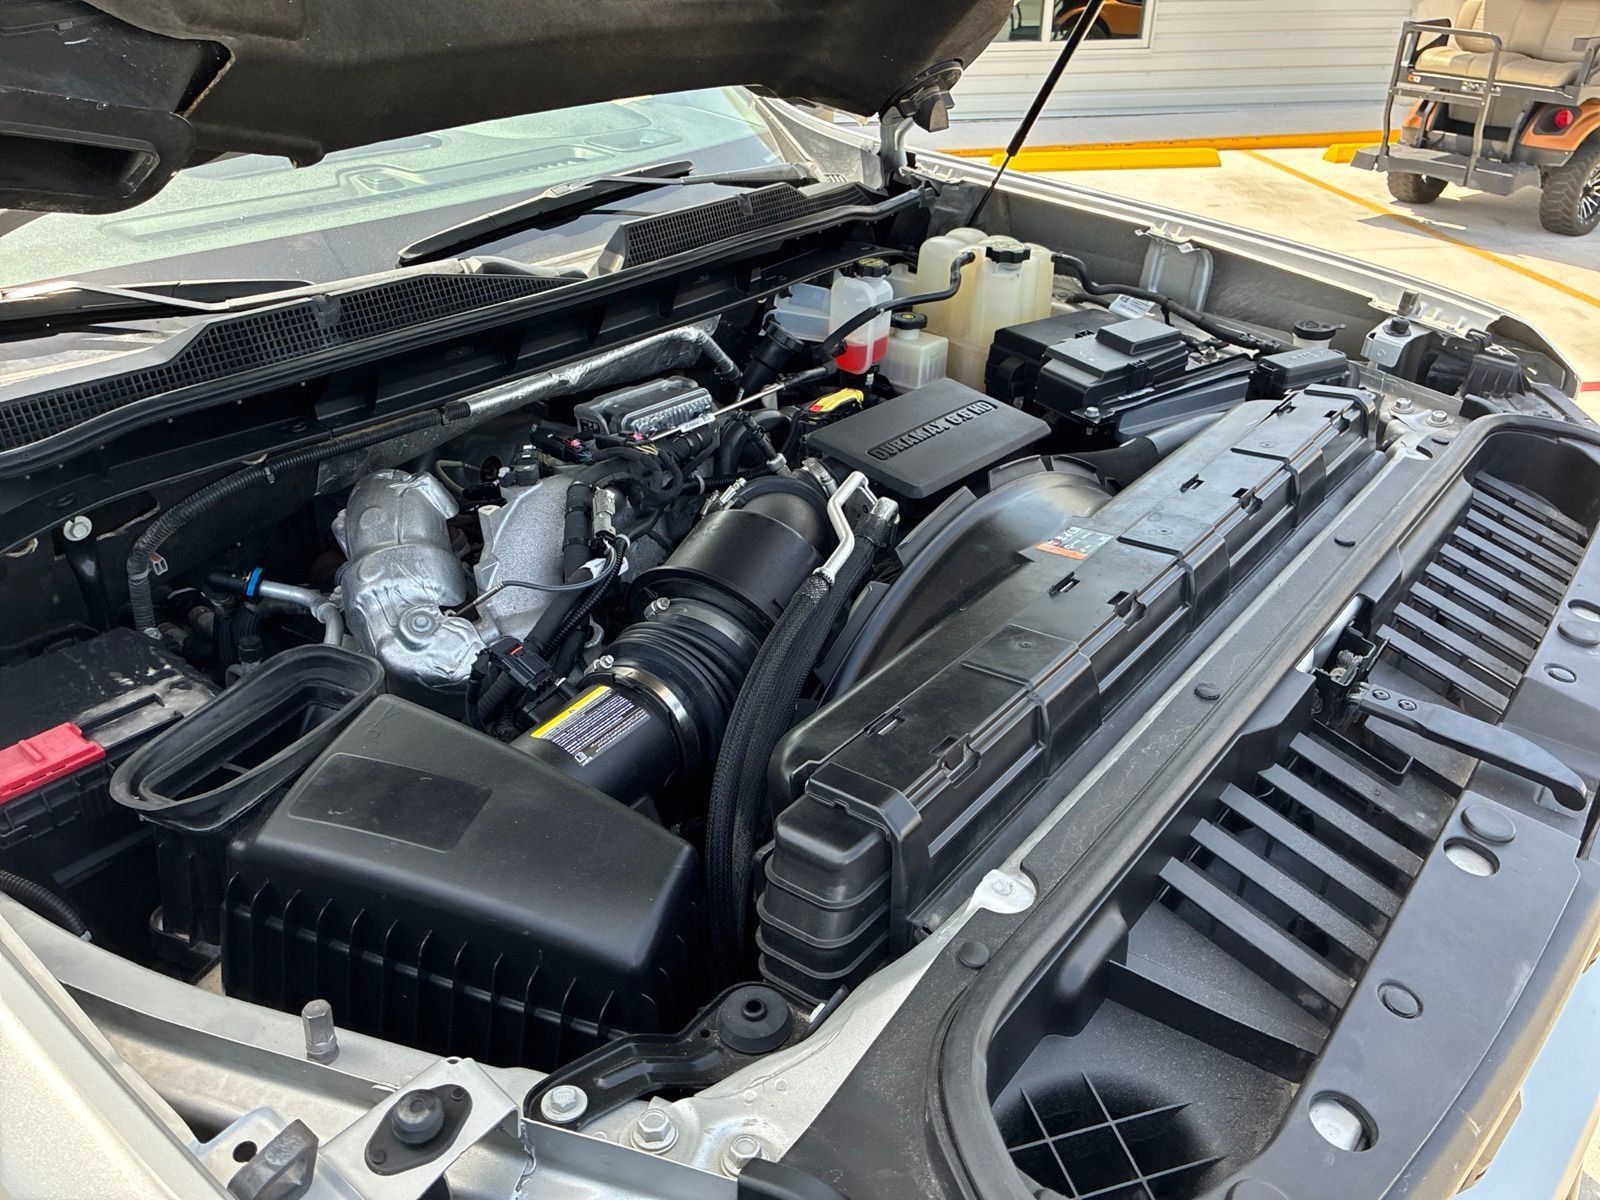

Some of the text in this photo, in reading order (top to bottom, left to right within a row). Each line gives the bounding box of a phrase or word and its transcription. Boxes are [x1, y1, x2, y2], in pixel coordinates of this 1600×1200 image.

[870, 401, 993, 460] DURAMAX 6.6 HD
